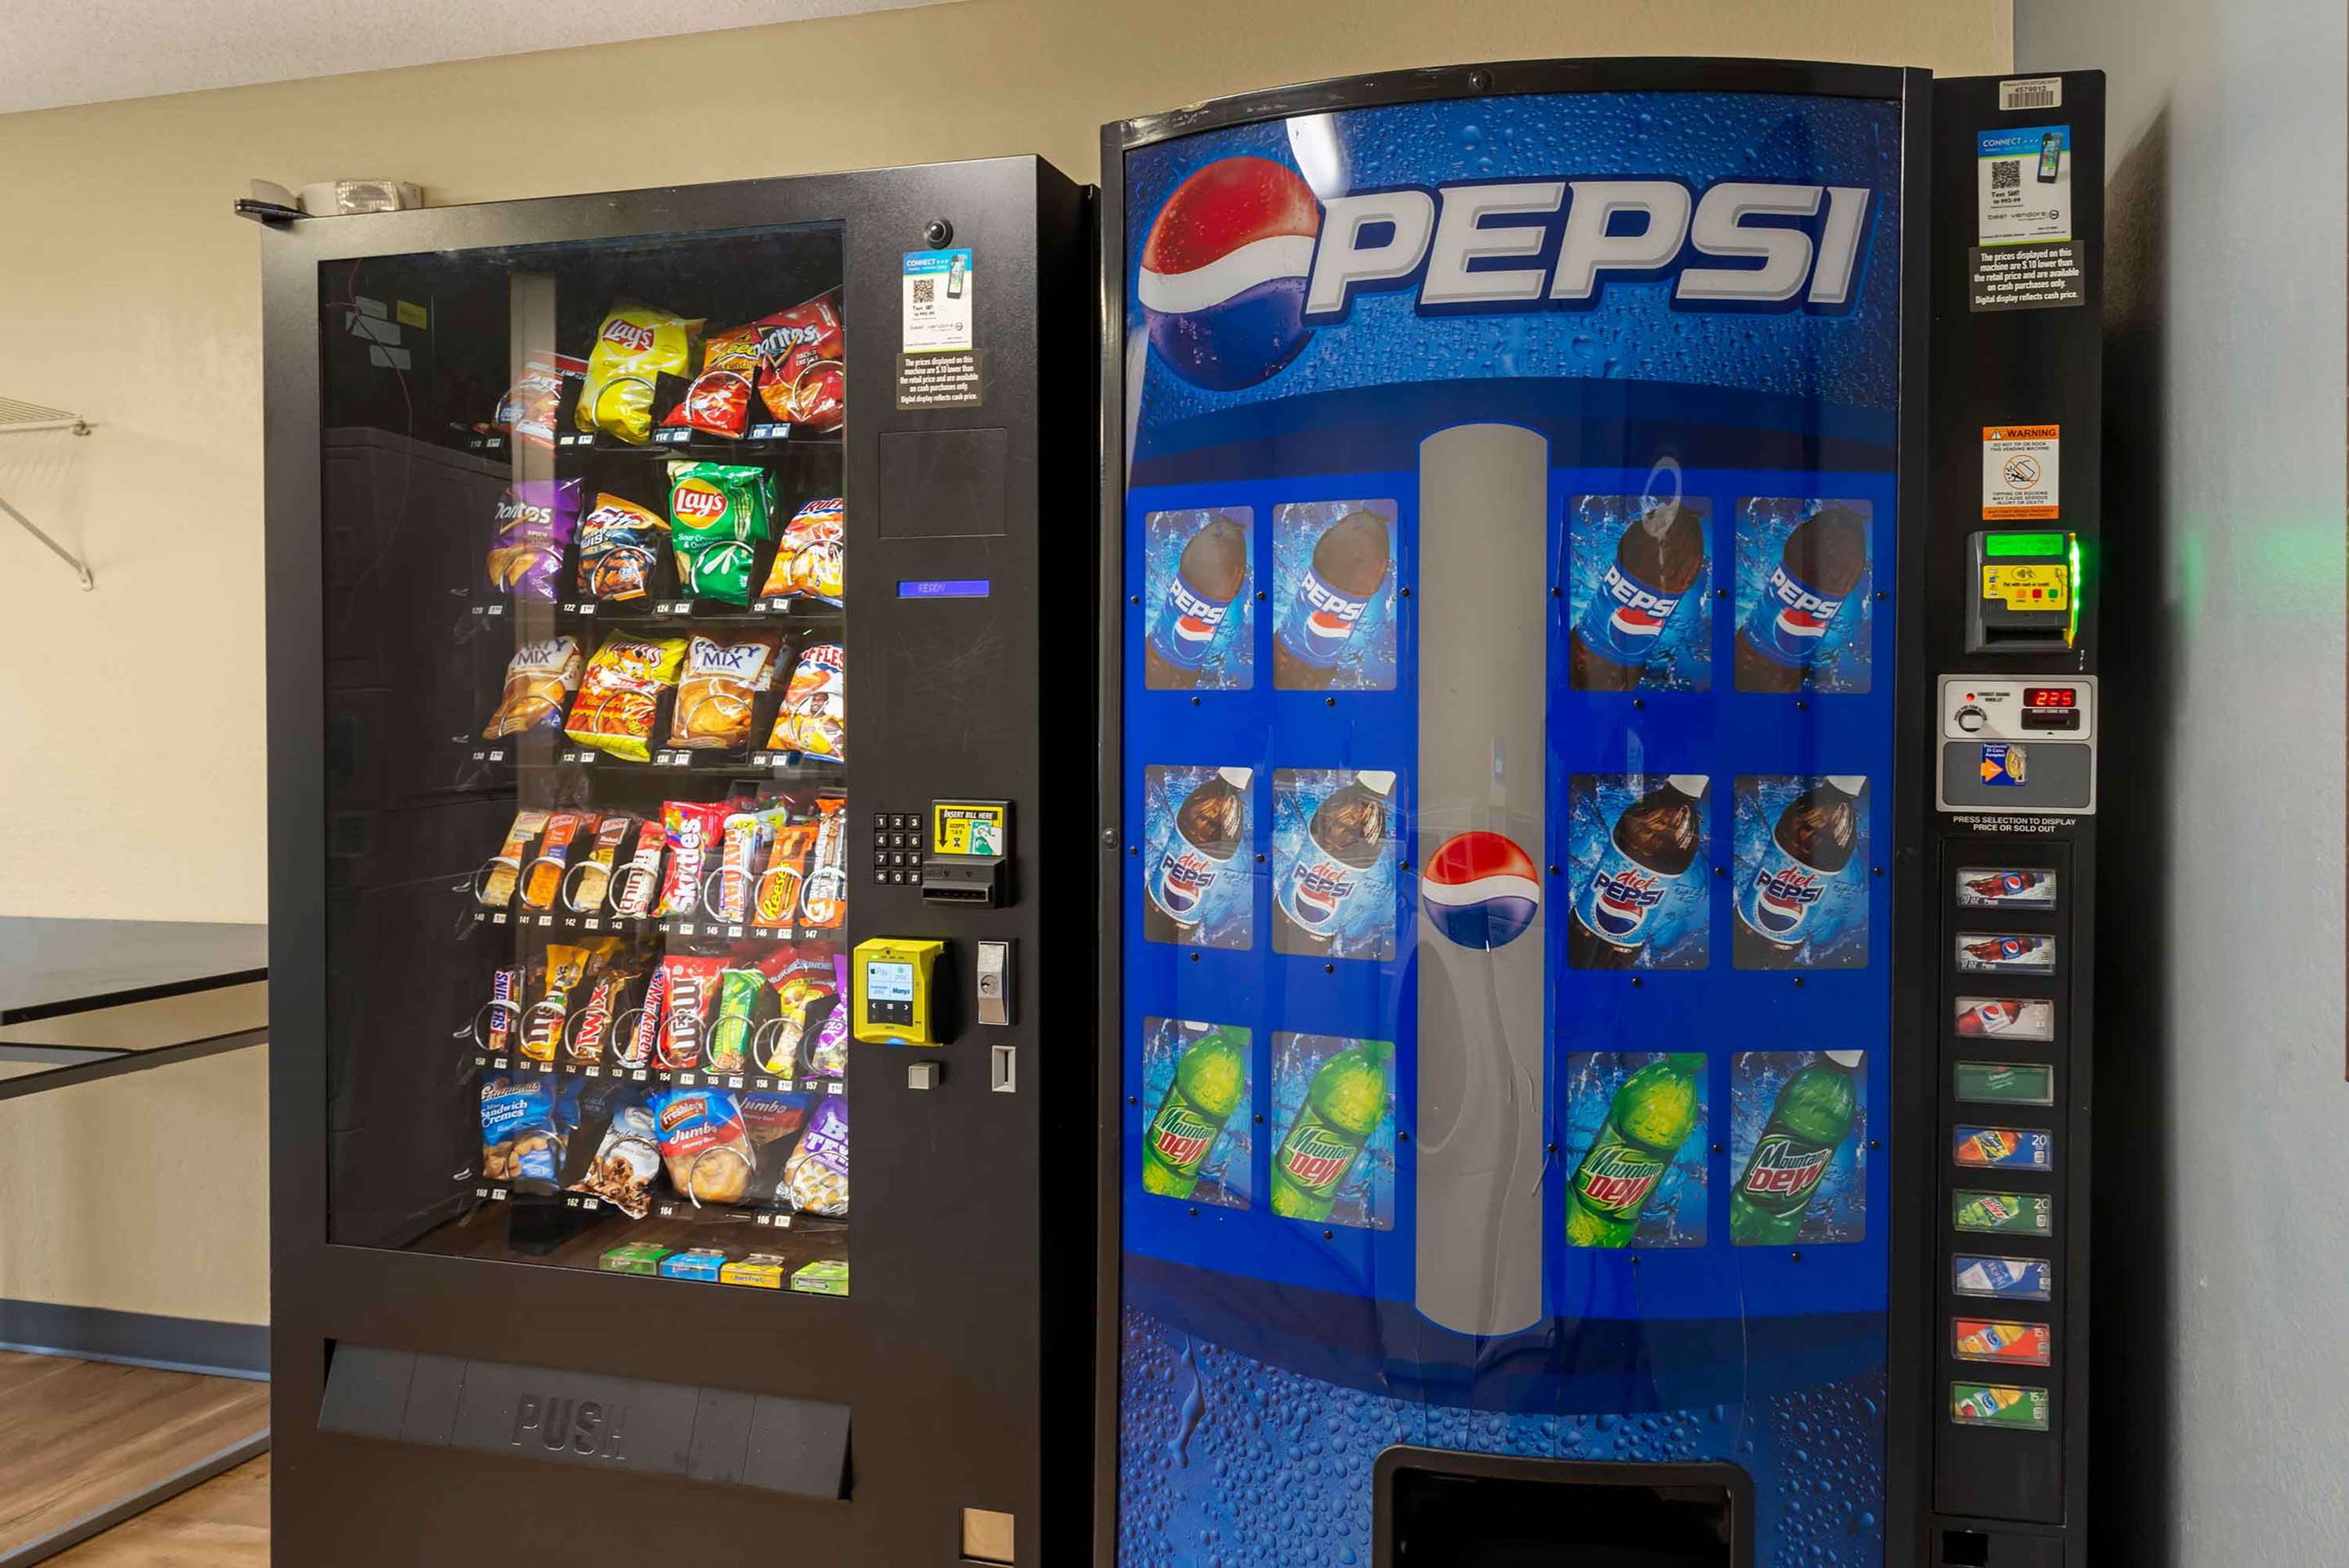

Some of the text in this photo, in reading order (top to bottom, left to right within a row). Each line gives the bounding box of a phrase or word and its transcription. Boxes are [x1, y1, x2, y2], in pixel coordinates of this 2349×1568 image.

[1983, 137, 2022, 147] CONNECT
[1305, 180, 1873, 316] PEPSI
[1981, 253, 1993, 262] The
[1994, 252, 2015, 264] prices
[2016, 250, 2048, 261] displayed
[2059, 248, 2072, 257] this
[1980, 262, 2009, 272] machine
[2022, 260, 2037, 269] $.10
[2037, 259, 2057, 268] lower
[2057, 259, 2073, 268] than
[1974, 273, 1985, 282] the
[1986, 272, 2004, 281] retail
[2004, 271, 2022, 282] price
[2023, 270, 2036, 279] and
[2049, 268, 2080, 277] available
[1997, 281, 2014, 290] cash
[2014, 280, 2050, 292] purchases
[2050, 278, 2067, 289] only.
[1974, 290, 2079, 305] Digital display reflects cash price.
[602, 319, 653, 351] Lay's
[2006, 428, 2056, 438] WARNING
[676, 488, 724, 517] Lay's
[1301, 571, 1367, 622] PEPSI
[1603, 565, 1680, 618] PEPSI
[1769, 566, 1842, 620] PEPSI
[1169, 577, 1227, 625] PEPSI
[656, 605, 669, 613] 124
[518, 650, 552, 665] MIX
[702, 652, 743, 669] MIX
[563, 754, 575, 762] 132
[943, 809, 964, 818] INSERT
[911, 818, 917, 826] 3
[1981, 816, 2028, 825] SELECTION
[2029, 817, 2040, 825] TO
[2041, 817, 2076, 826] DISPLAY
[1178, 853, 1211, 872] diet
[1162, 853, 1216, 888] PEPSI
[1310, 860, 1348, 883] diet
[1775, 866, 1818, 888] diet
[911, 874, 918, 882] #
[1293, 862, 1354, 898] PEPSI
[1615, 868, 1659, 892] diet
[1593, 870, 1664, 907] PEPSI
[1755, 868, 1824, 906] PEPSI
[520, 915, 530, 924] 141
[565, 918, 577, 927] 142
[612, 921, 623, 929] 143
[658, 924, 670, 932] 144
[707, 926, 719, 935] 145
[756, 928, 768, 937] 146
[804, 930, 817, 939] 147
[491, 971, 509, 1031] SNICERS
[574, 986, 612, 1061] TWIX
[520, 1061, 530, 1070] 151
[611, 1069, 623, 1077] 153
[659, 1072, 671, 1081] 154
[707, 1076, 719, 1084] 155
[756, 1079, 768, 1087] 156
[805, 1081, 818, 1089] 157
[482, 1109, 525, 1127] Cremes
[1159, 1107, 1217, 1142] Mountain
[669, 1122, 717, 1145] Jumbo
[2031, 1135, 2047, 1146] 20
[1289, 1126, 1358, 1159] Mountain
[1758, 1139, 1833, 1169] Mountain
[1587, 1146, 1664, 1178] Mountain
[566, 1198, 579, 1207] 162
[660, 1206, 672, 1216] 164
[757, 1215, 769, 1225] 166
[511, 1391, 631, 1461] PUSH
